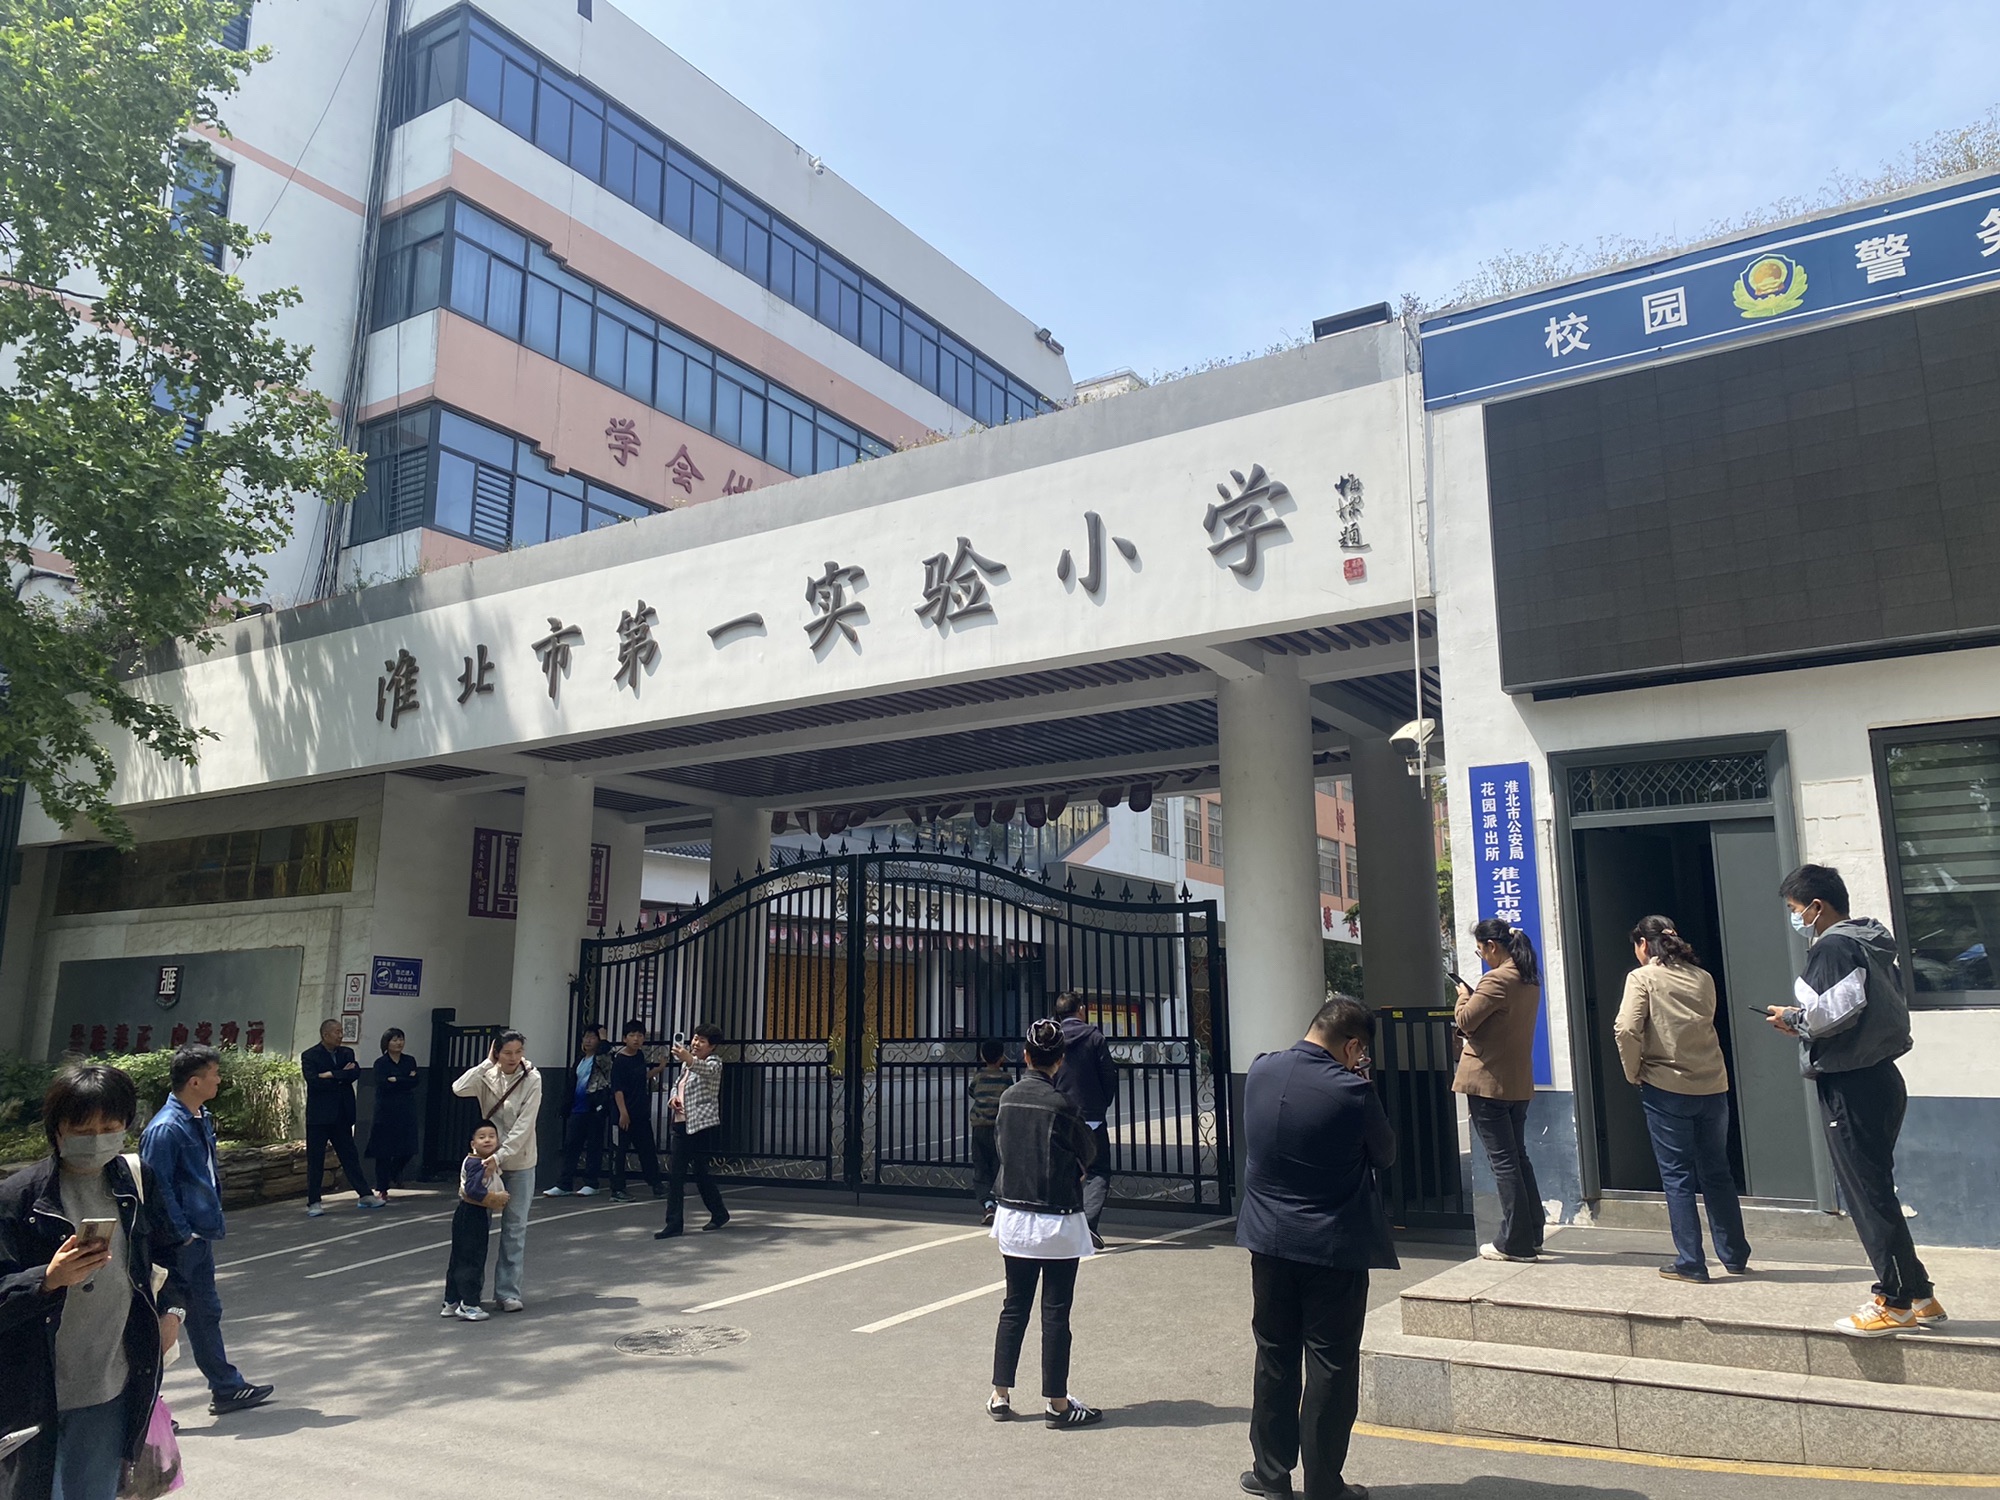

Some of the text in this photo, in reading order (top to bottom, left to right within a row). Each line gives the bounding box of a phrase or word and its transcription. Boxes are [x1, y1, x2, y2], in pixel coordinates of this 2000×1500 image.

[1545, 286, 1688, 358] 校园
[376, 463, 1288, 729] 淮北市第一实验小学
[1481, 782, 1499, 861] 花园派出所
[1504, 780, 1524, 860] 淮北市公安局
[1492, 867, 1523, 931] 淮北市第
